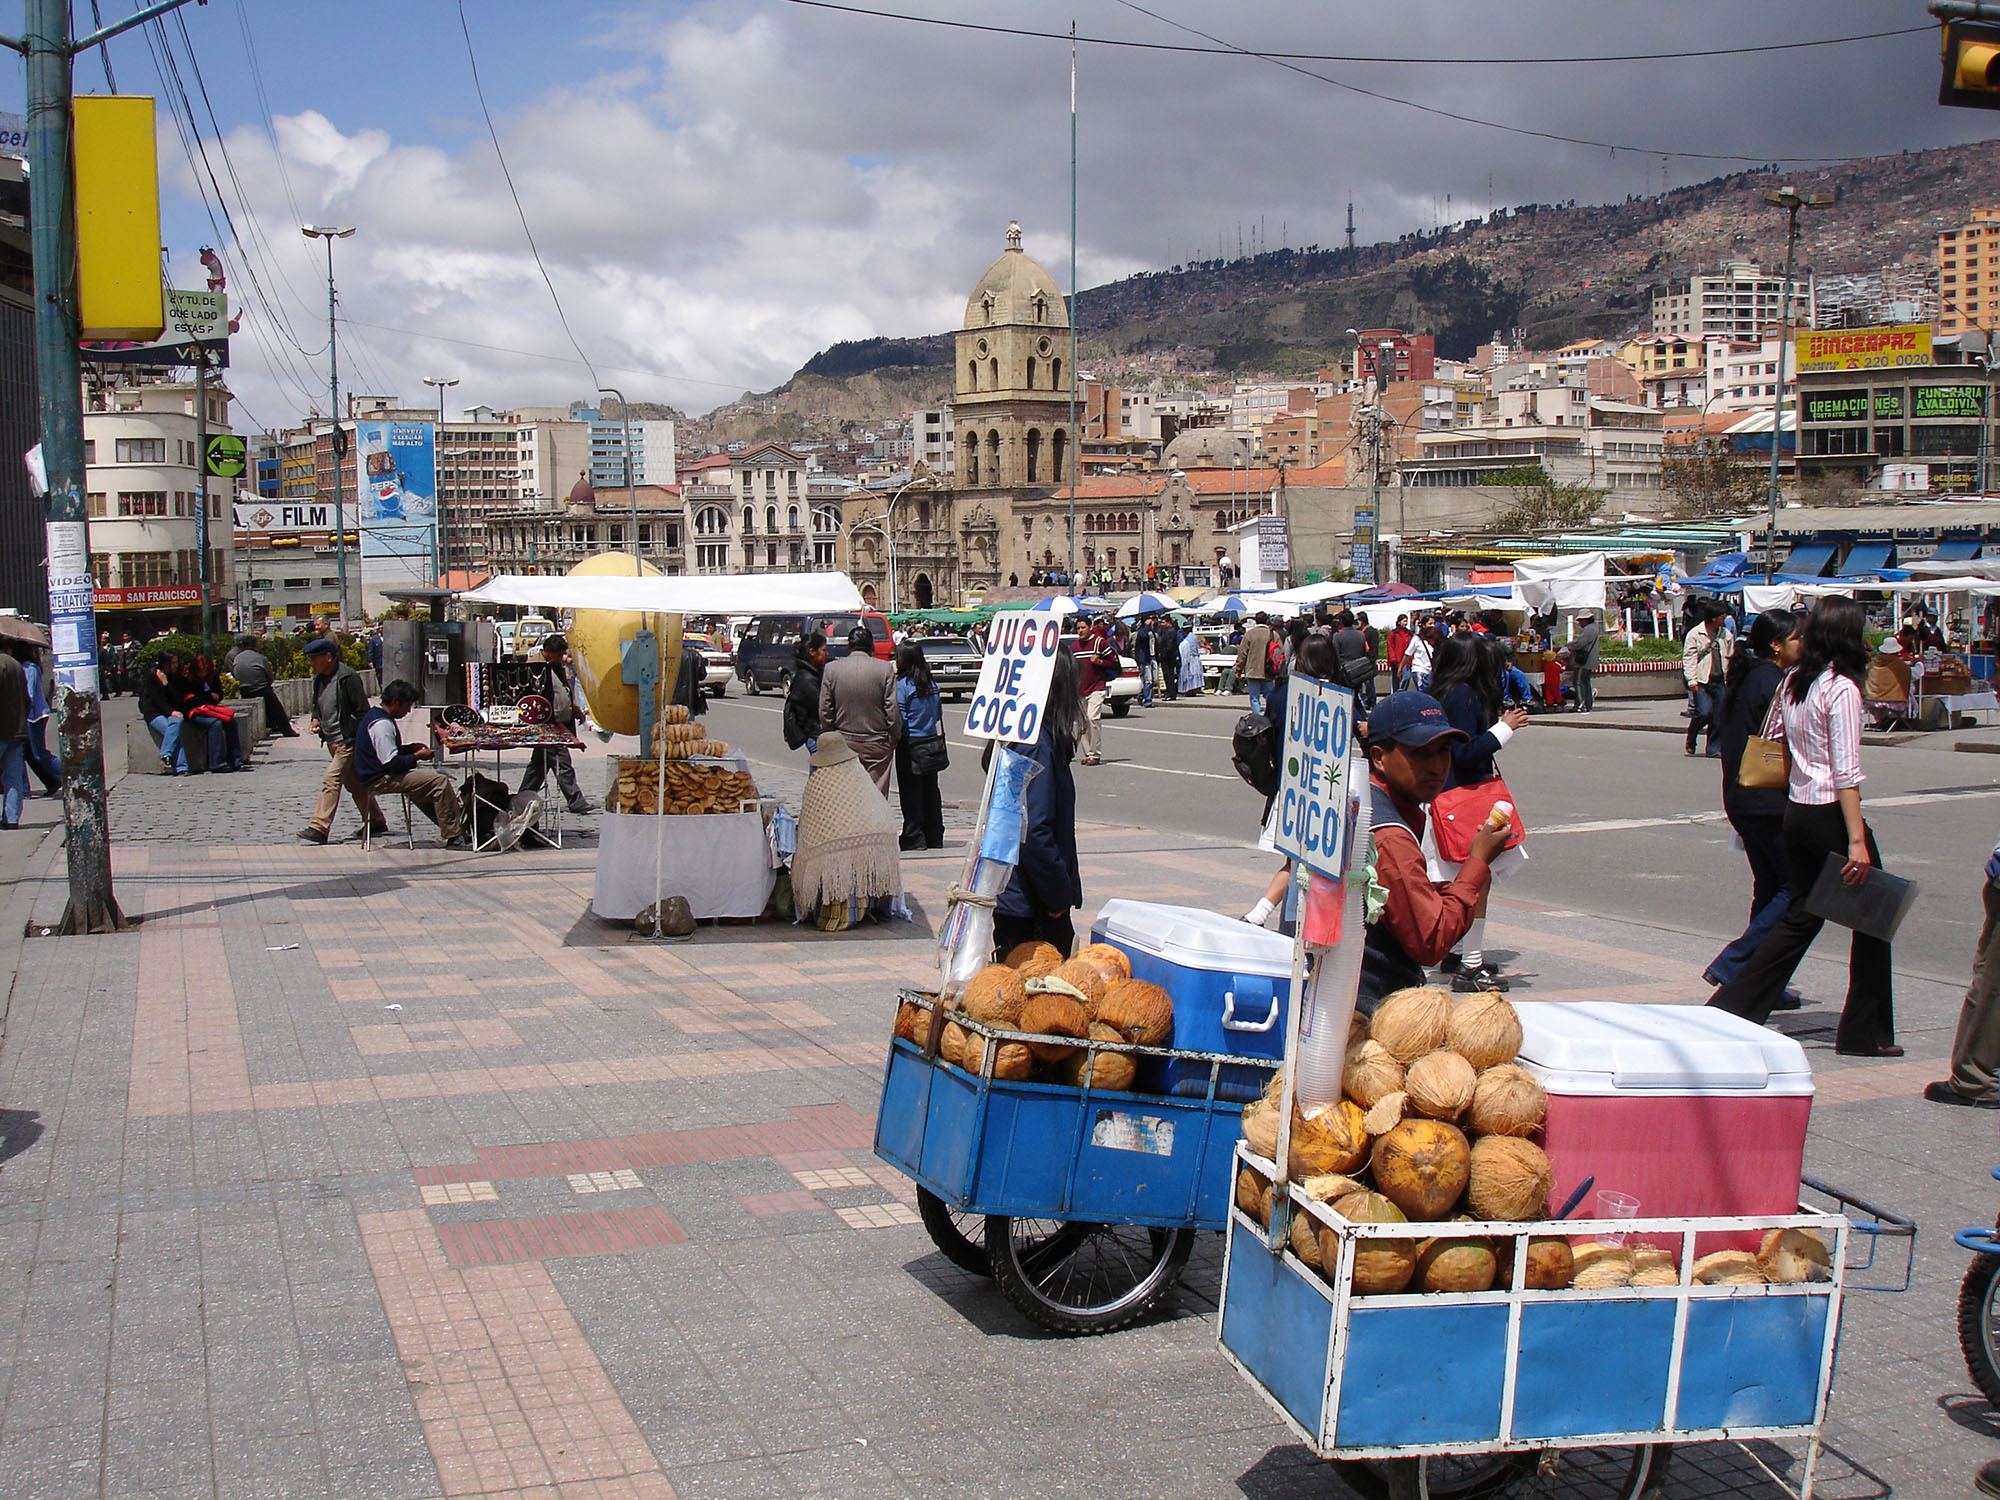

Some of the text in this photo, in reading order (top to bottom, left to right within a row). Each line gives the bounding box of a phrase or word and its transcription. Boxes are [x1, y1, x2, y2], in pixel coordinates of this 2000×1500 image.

[191, 311, 218, 320] LADO
[203, 297, 216, 306] DE
[283, 506, 327, 527] FILM
[49, 575, 91, 588] VIDEO
[127, 592, 146, 603] SAN
[147, 589, 198, 601] FRANCISCO
[988, 618, 1060, 658] JUGO
[994, 657, 1026, 696] DE
[967, 695, 1038, 740] COCO
[1290, 692, 1347, 758] JUGO
[1300, 751, 1322, 795] DE
[1282, 788, 1338, 857] COCO
